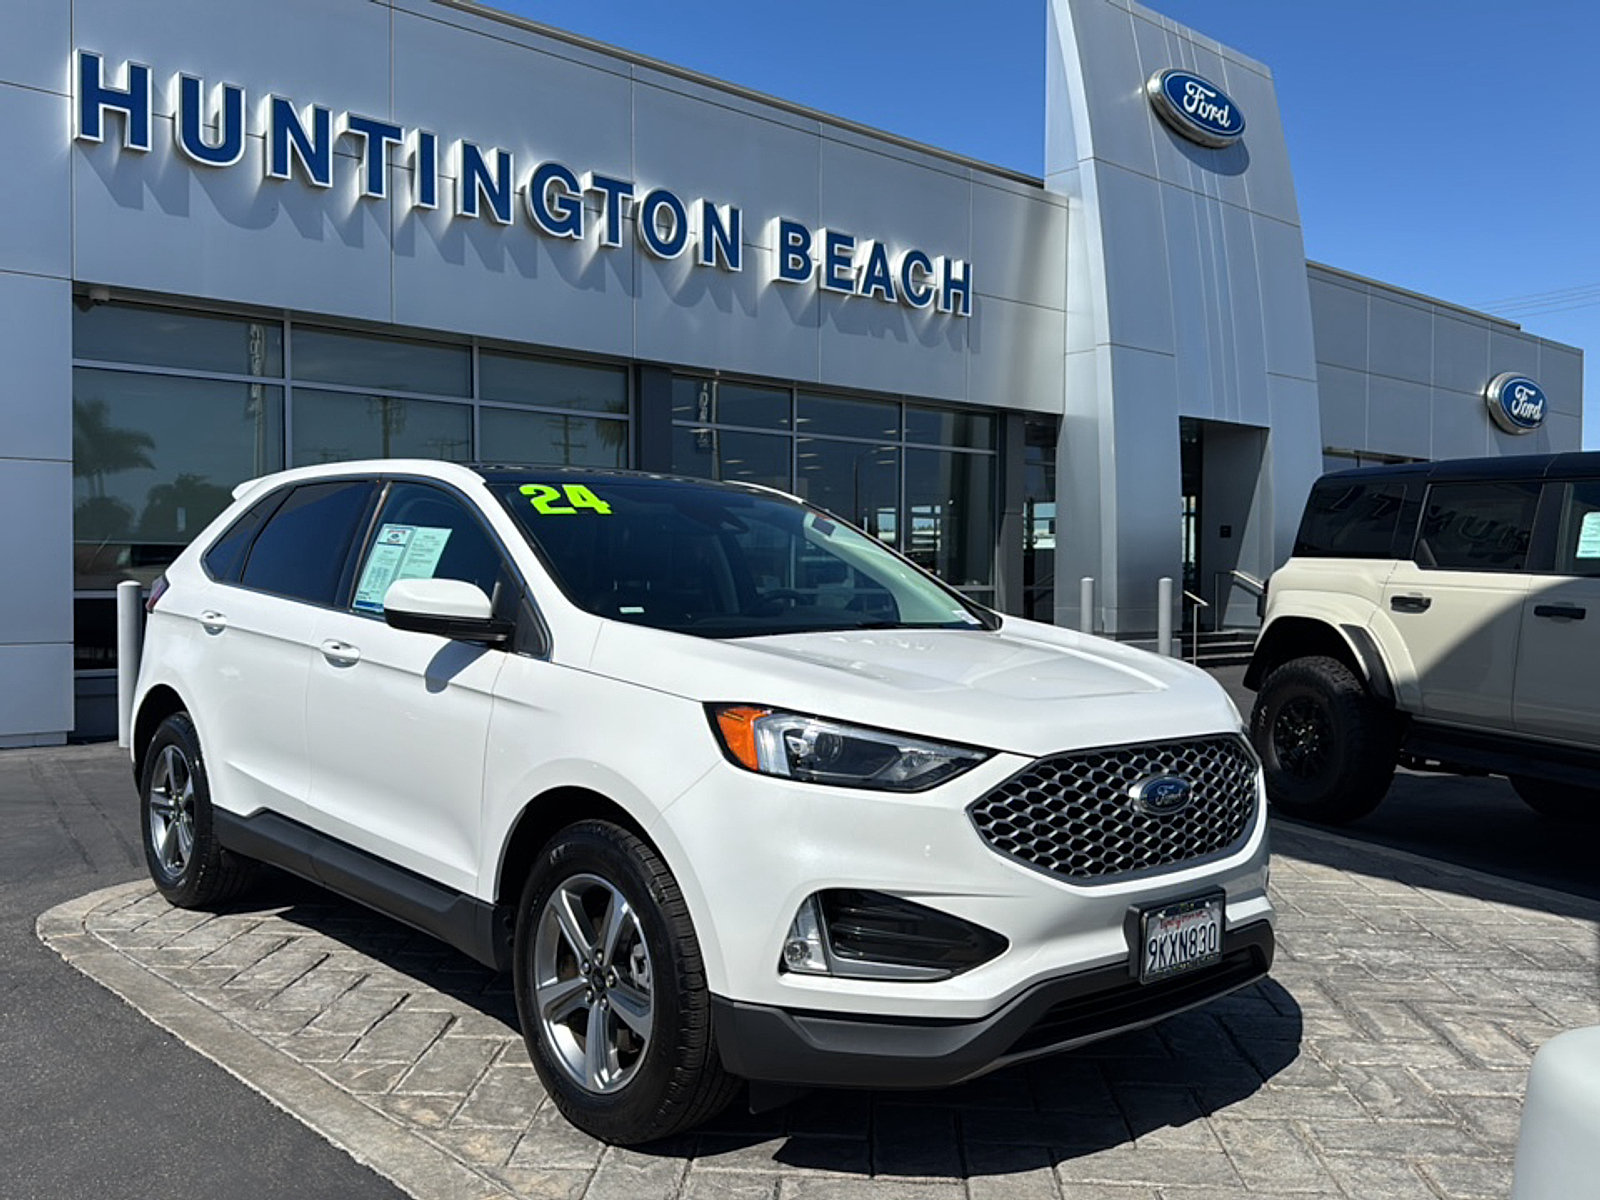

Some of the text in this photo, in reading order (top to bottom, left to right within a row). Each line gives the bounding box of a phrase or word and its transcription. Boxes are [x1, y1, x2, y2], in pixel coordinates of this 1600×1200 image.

[1183, 81, 1231, 128] Ford
[74, 49, 972, 317] HUNTINGTON BEACH
[1511, 385, 1543, 420] Ford
[519, 484, 612, 515] 24
[1147, 921, 1217, 973] 9KXN830
